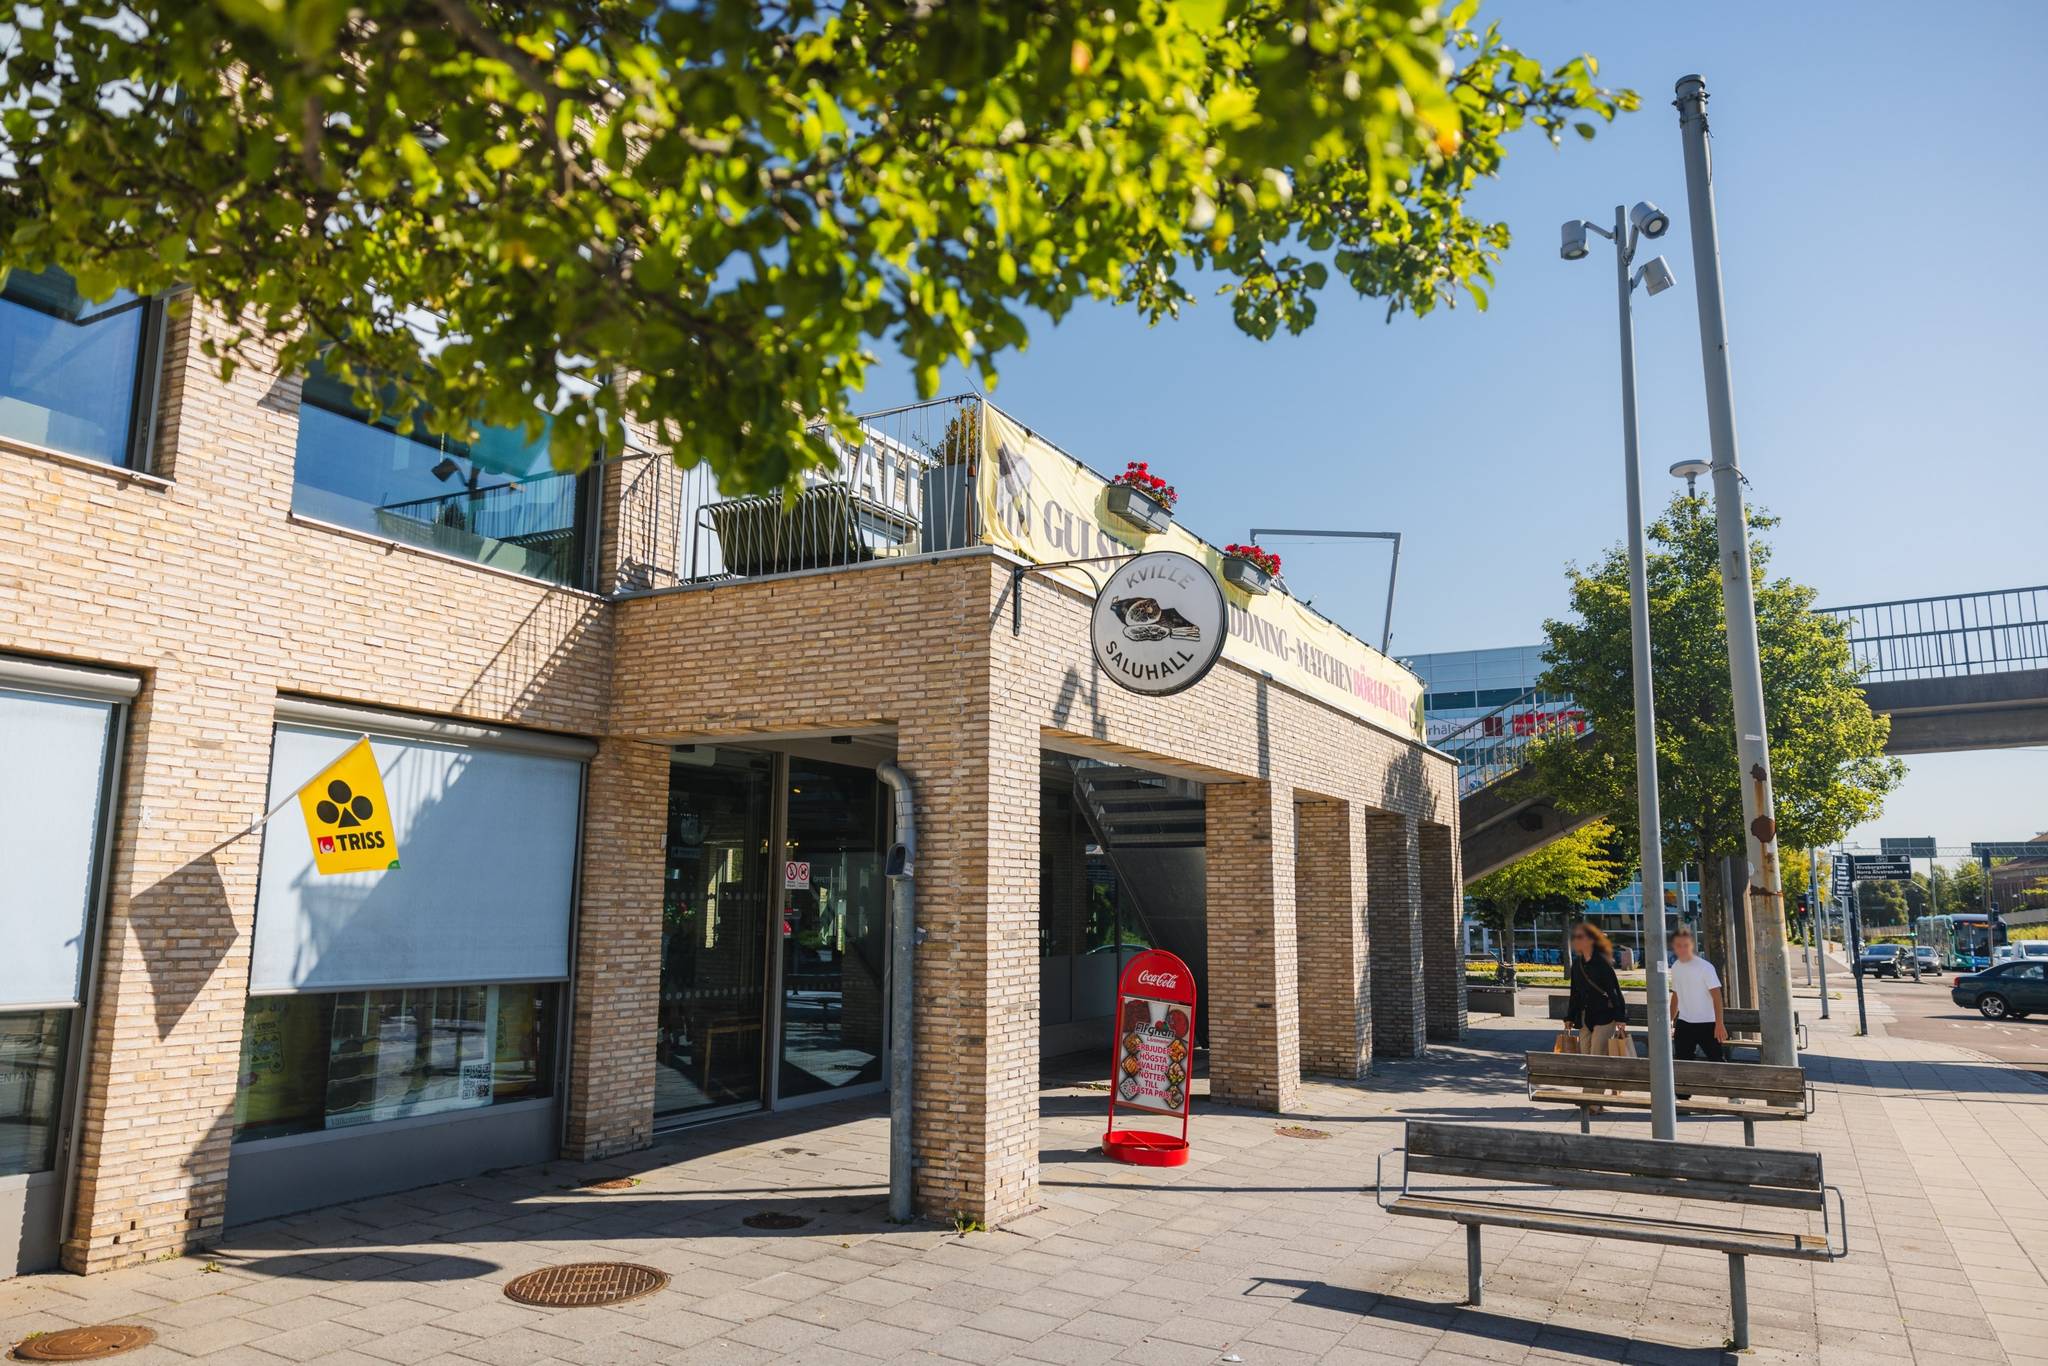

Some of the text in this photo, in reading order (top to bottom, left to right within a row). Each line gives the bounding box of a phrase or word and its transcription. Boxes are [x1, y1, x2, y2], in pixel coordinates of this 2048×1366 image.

[1126, 565, 1195, 590] KVILLE
[1228, 604, 1353, 694] DDNING-MATCHEN
[1106, 640, 1194, 680] SALUHALL
[336, 831, 385, 852] TRISS
[1136, 1043, 1172, 1055] ERBJUDER
[1140, 1052, 1167, 1063] HÖGSTA
[1137, 1061, 1169, 1072] KVALITET
[1139, 1070, 1166, 1082] NÖTTER
[1145, 1080, 1158, 1089] TILL
